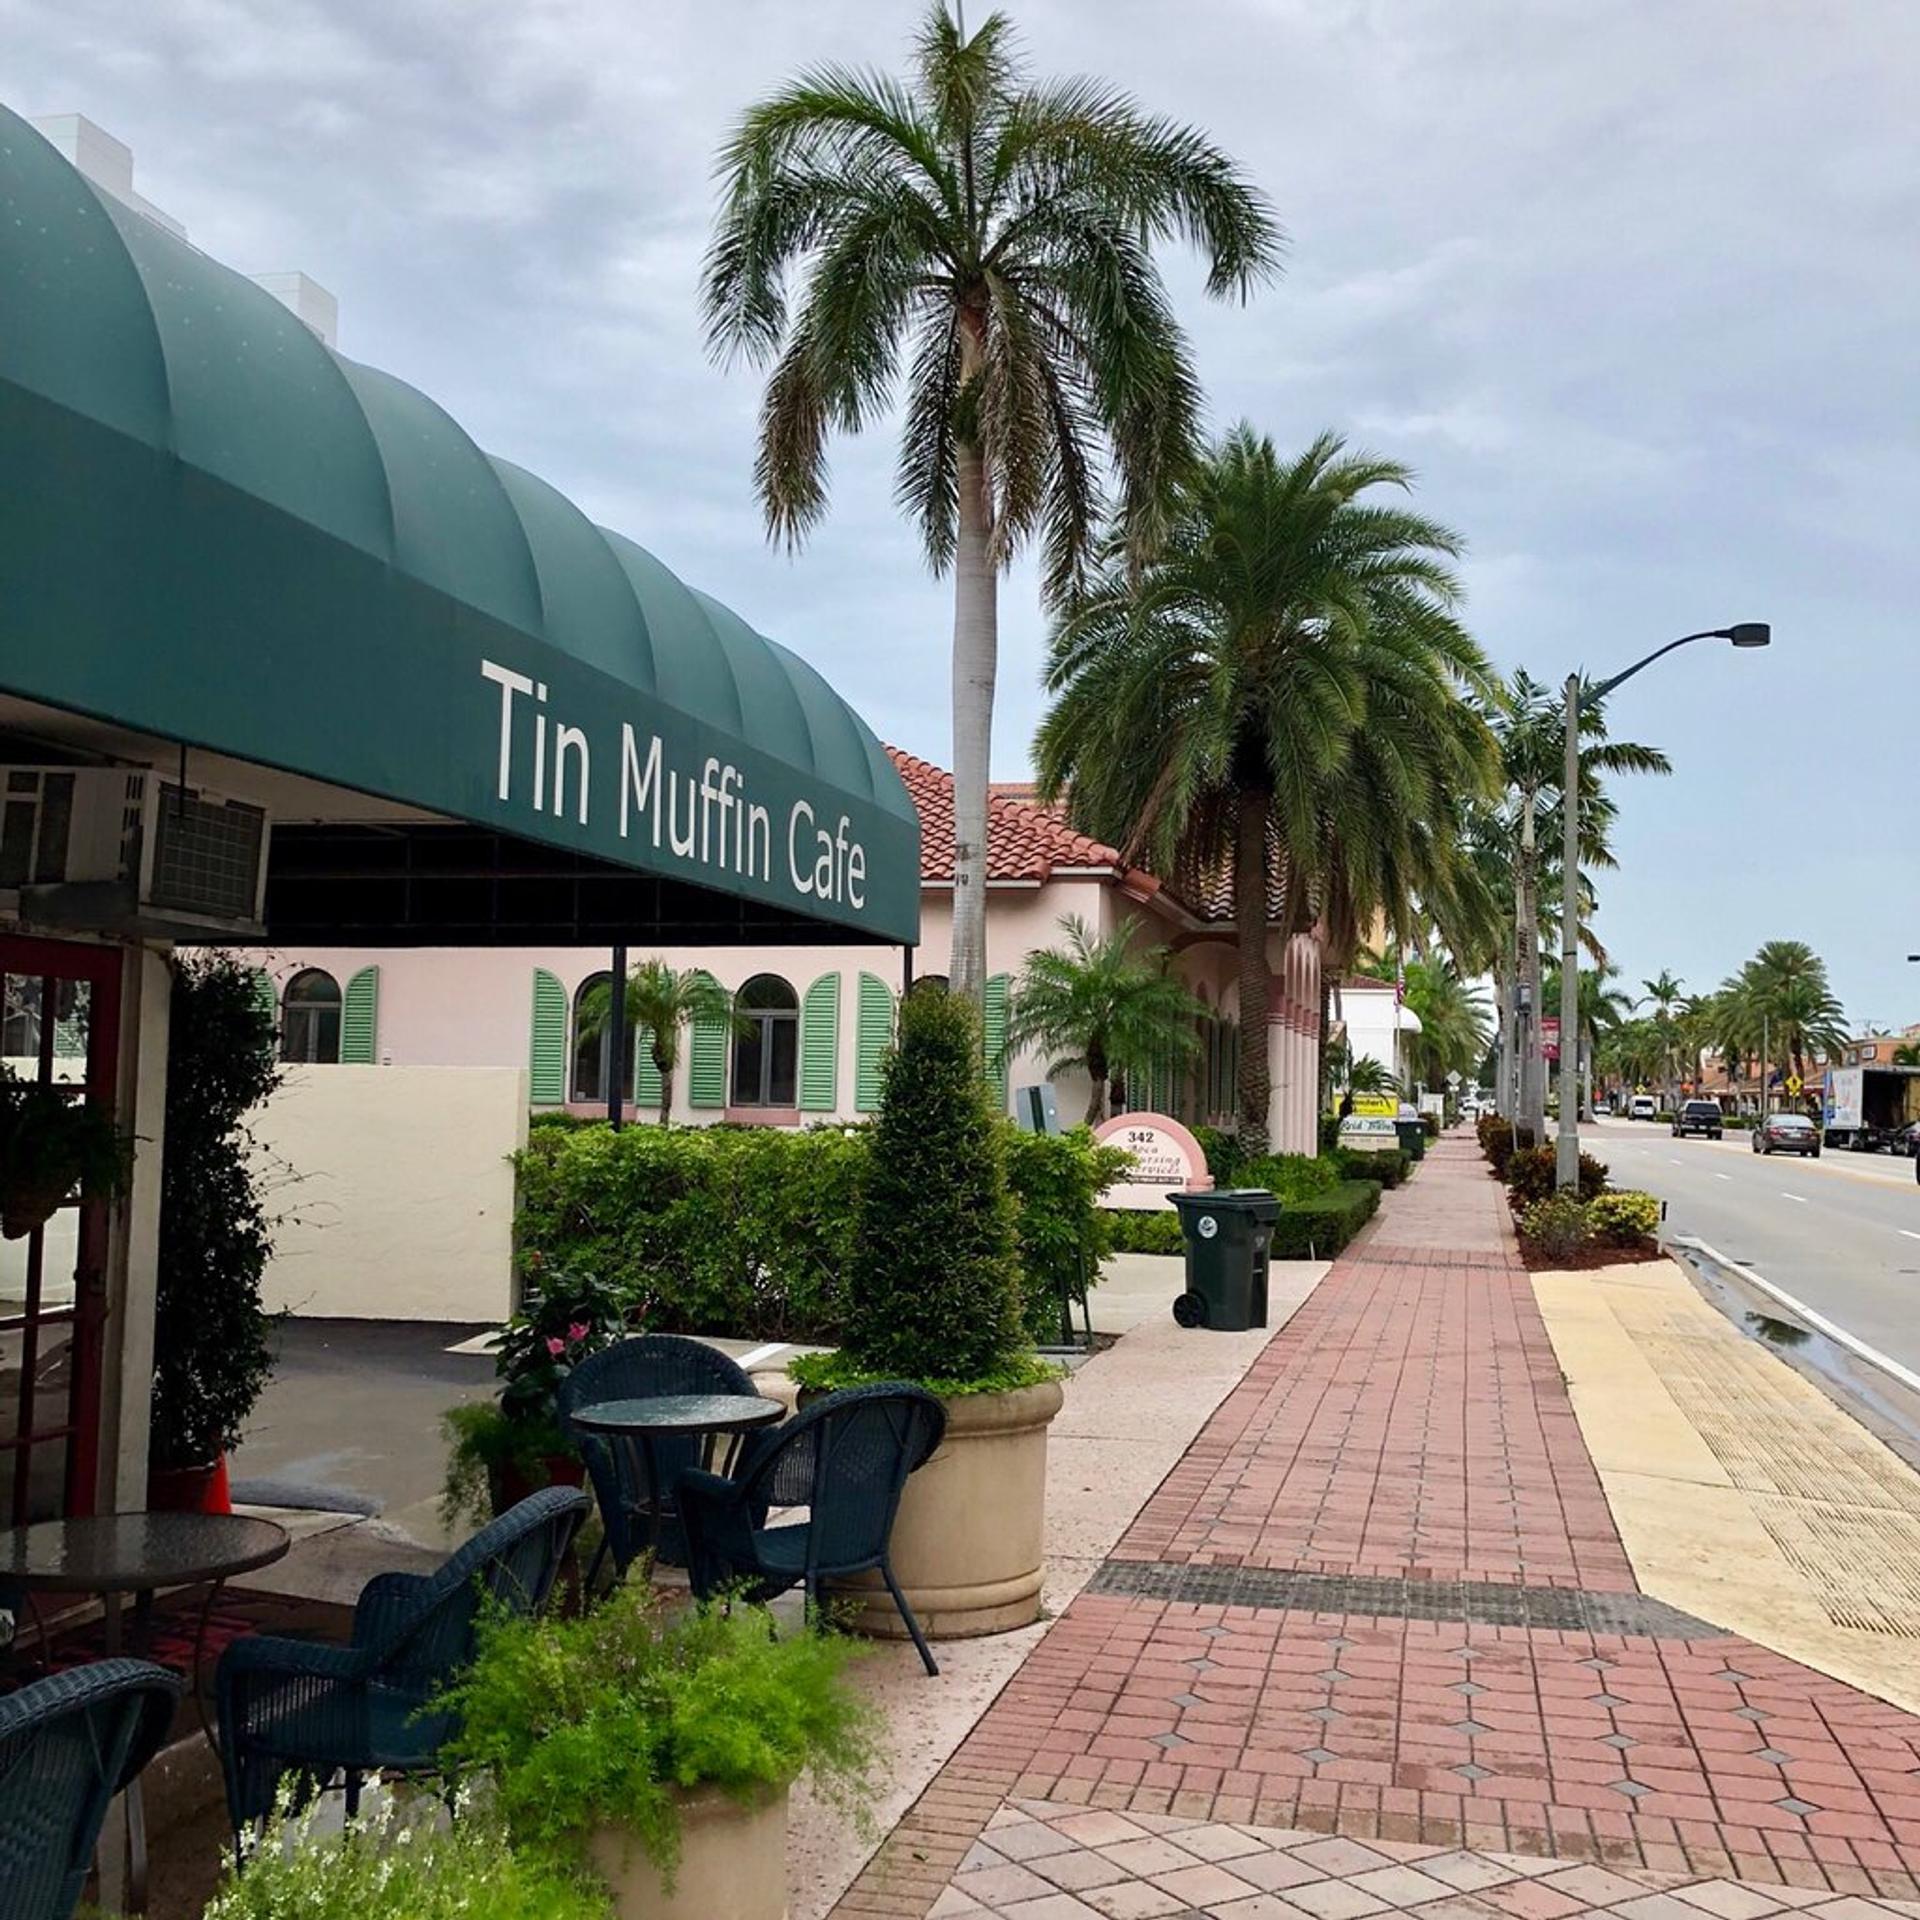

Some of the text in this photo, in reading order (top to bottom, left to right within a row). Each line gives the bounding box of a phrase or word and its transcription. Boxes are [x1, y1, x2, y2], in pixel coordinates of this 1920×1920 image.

[481, 659, 867, 909] Tin Muffin Cafe
[1128, 1131, 1155, 1143] 342
